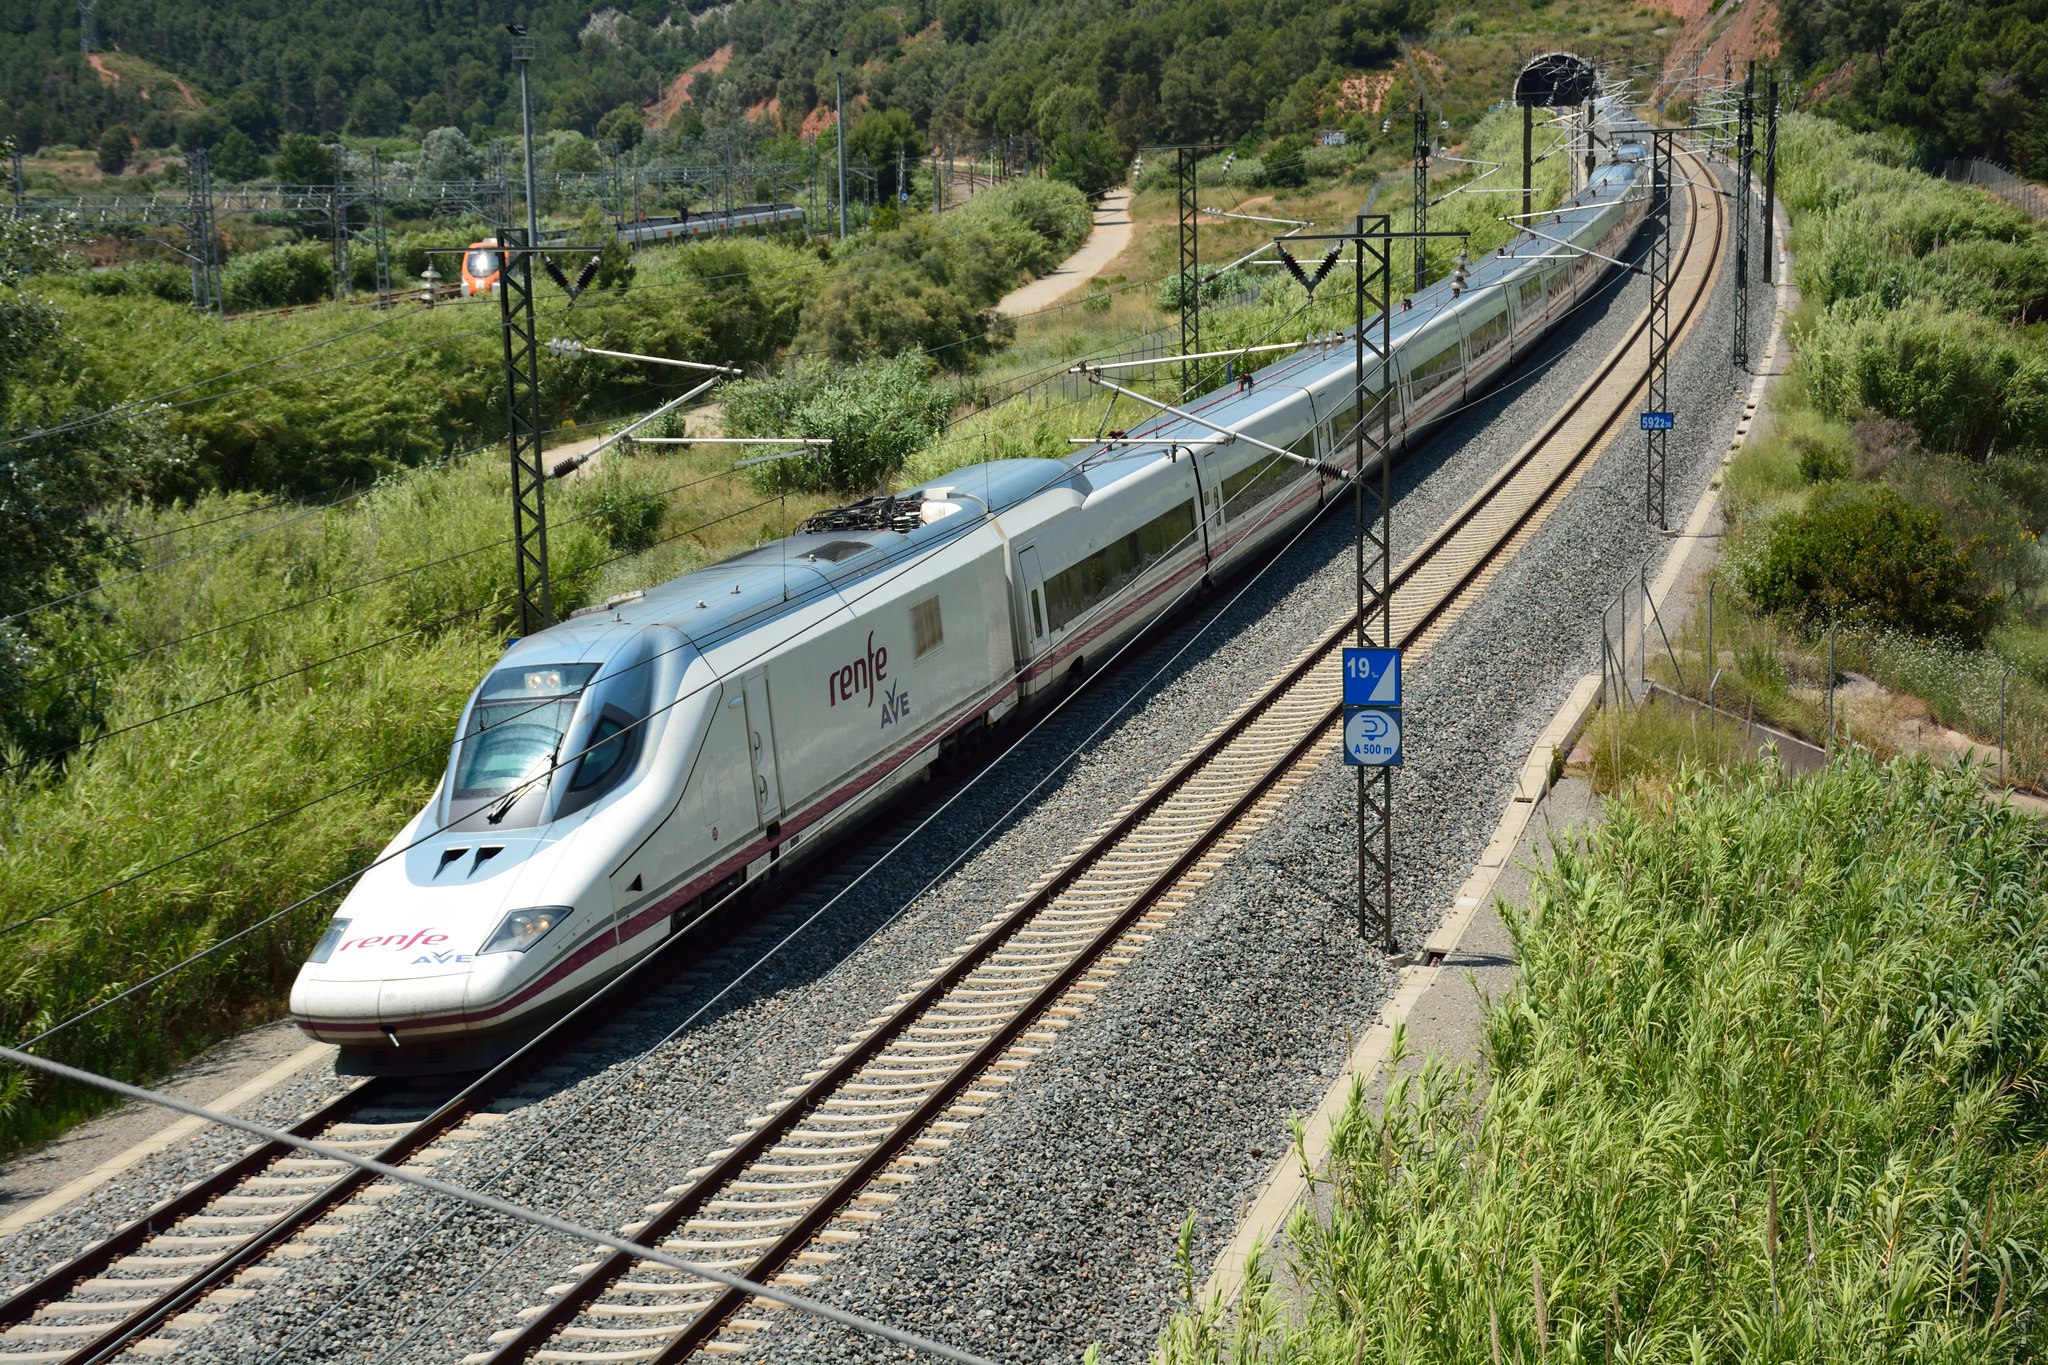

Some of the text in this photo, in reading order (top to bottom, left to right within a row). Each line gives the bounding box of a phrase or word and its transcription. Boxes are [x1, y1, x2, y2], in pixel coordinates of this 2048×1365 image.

[829, 630, 887, 708] renfe
[880, 678, 910, 729] AVE
[1354, 744, 1392, 755] A 500 m
[339, 927, 449, 951] renfe
[411, 948, 473, 965] AVE
